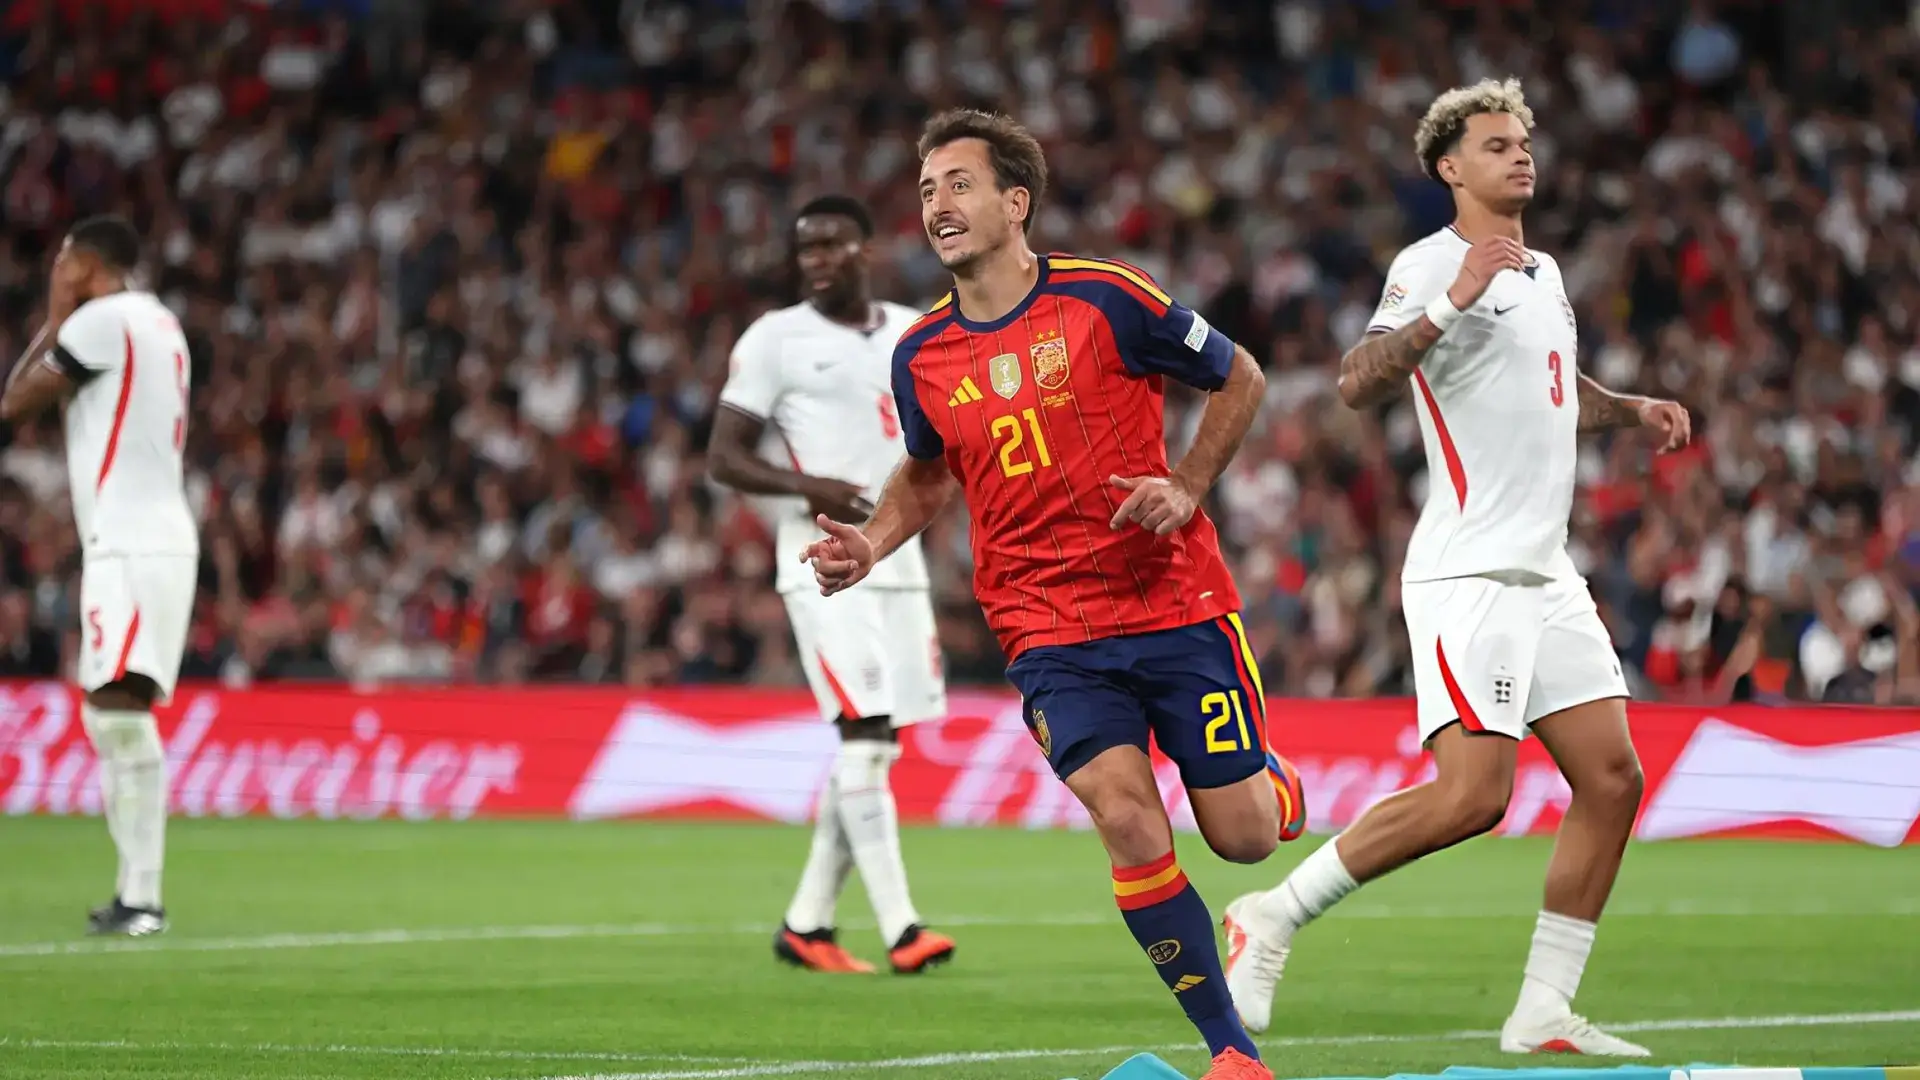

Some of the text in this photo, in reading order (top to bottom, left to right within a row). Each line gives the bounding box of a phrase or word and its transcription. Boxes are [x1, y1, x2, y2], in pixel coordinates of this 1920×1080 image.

[1549, 350, 1564, 407] 3
[991, 407, 1052, 478] 21
[88, 607, 105, 651] 5
[1201, 690, 1252, 754] 21
